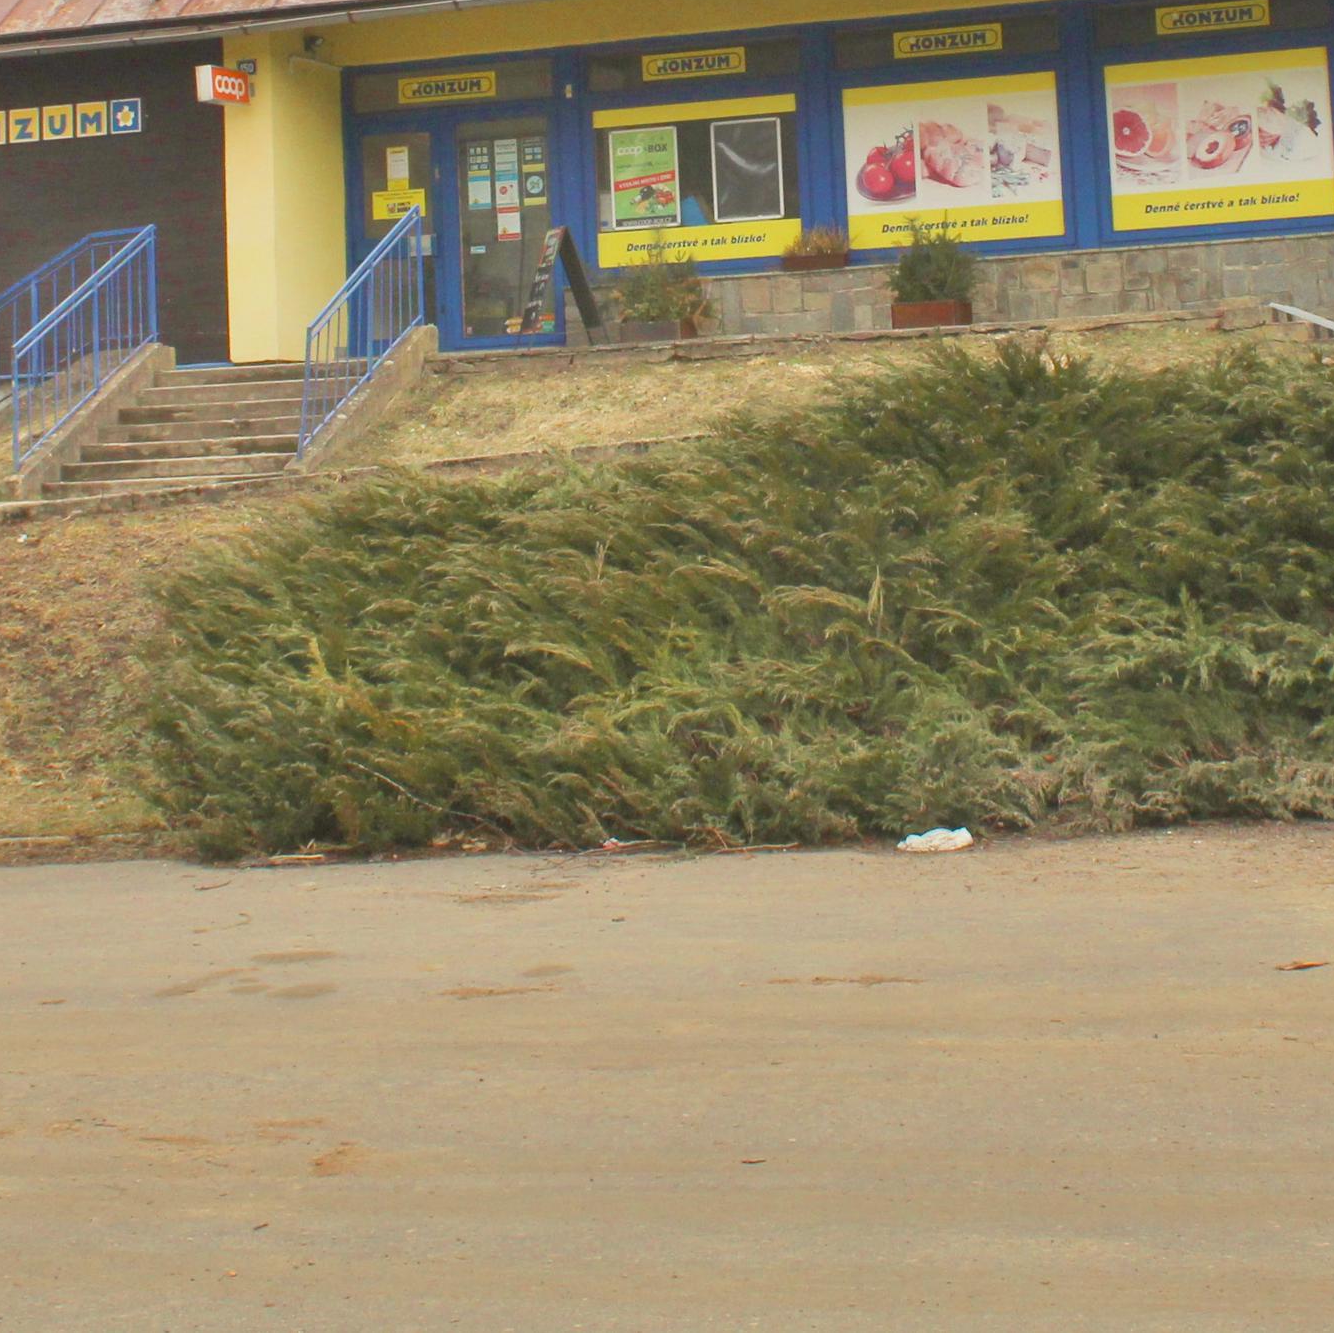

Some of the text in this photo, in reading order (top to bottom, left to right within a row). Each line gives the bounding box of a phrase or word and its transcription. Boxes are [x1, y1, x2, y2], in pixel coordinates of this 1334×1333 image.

[1172, 8, 1253, 27] KONZUM
[910, 32, 987, 52] KONZUM
[657, 55, 730, 74] KONZUM
[214, 74, 245, 99] coop
[411, 79, 482, 97] KONZUM
[1238, 196, 1257, 206] tak
[1261, 193, 1300, 205] blízko!
[961, 220, 967, 228] a
[970, 217, 988, 227] tak
[992, 214, 1030, 225] blízko!
[701, 239, 708, 247] a
[710, 236, 727, 246] tak
[731, 233, 767, 244] blízko!
